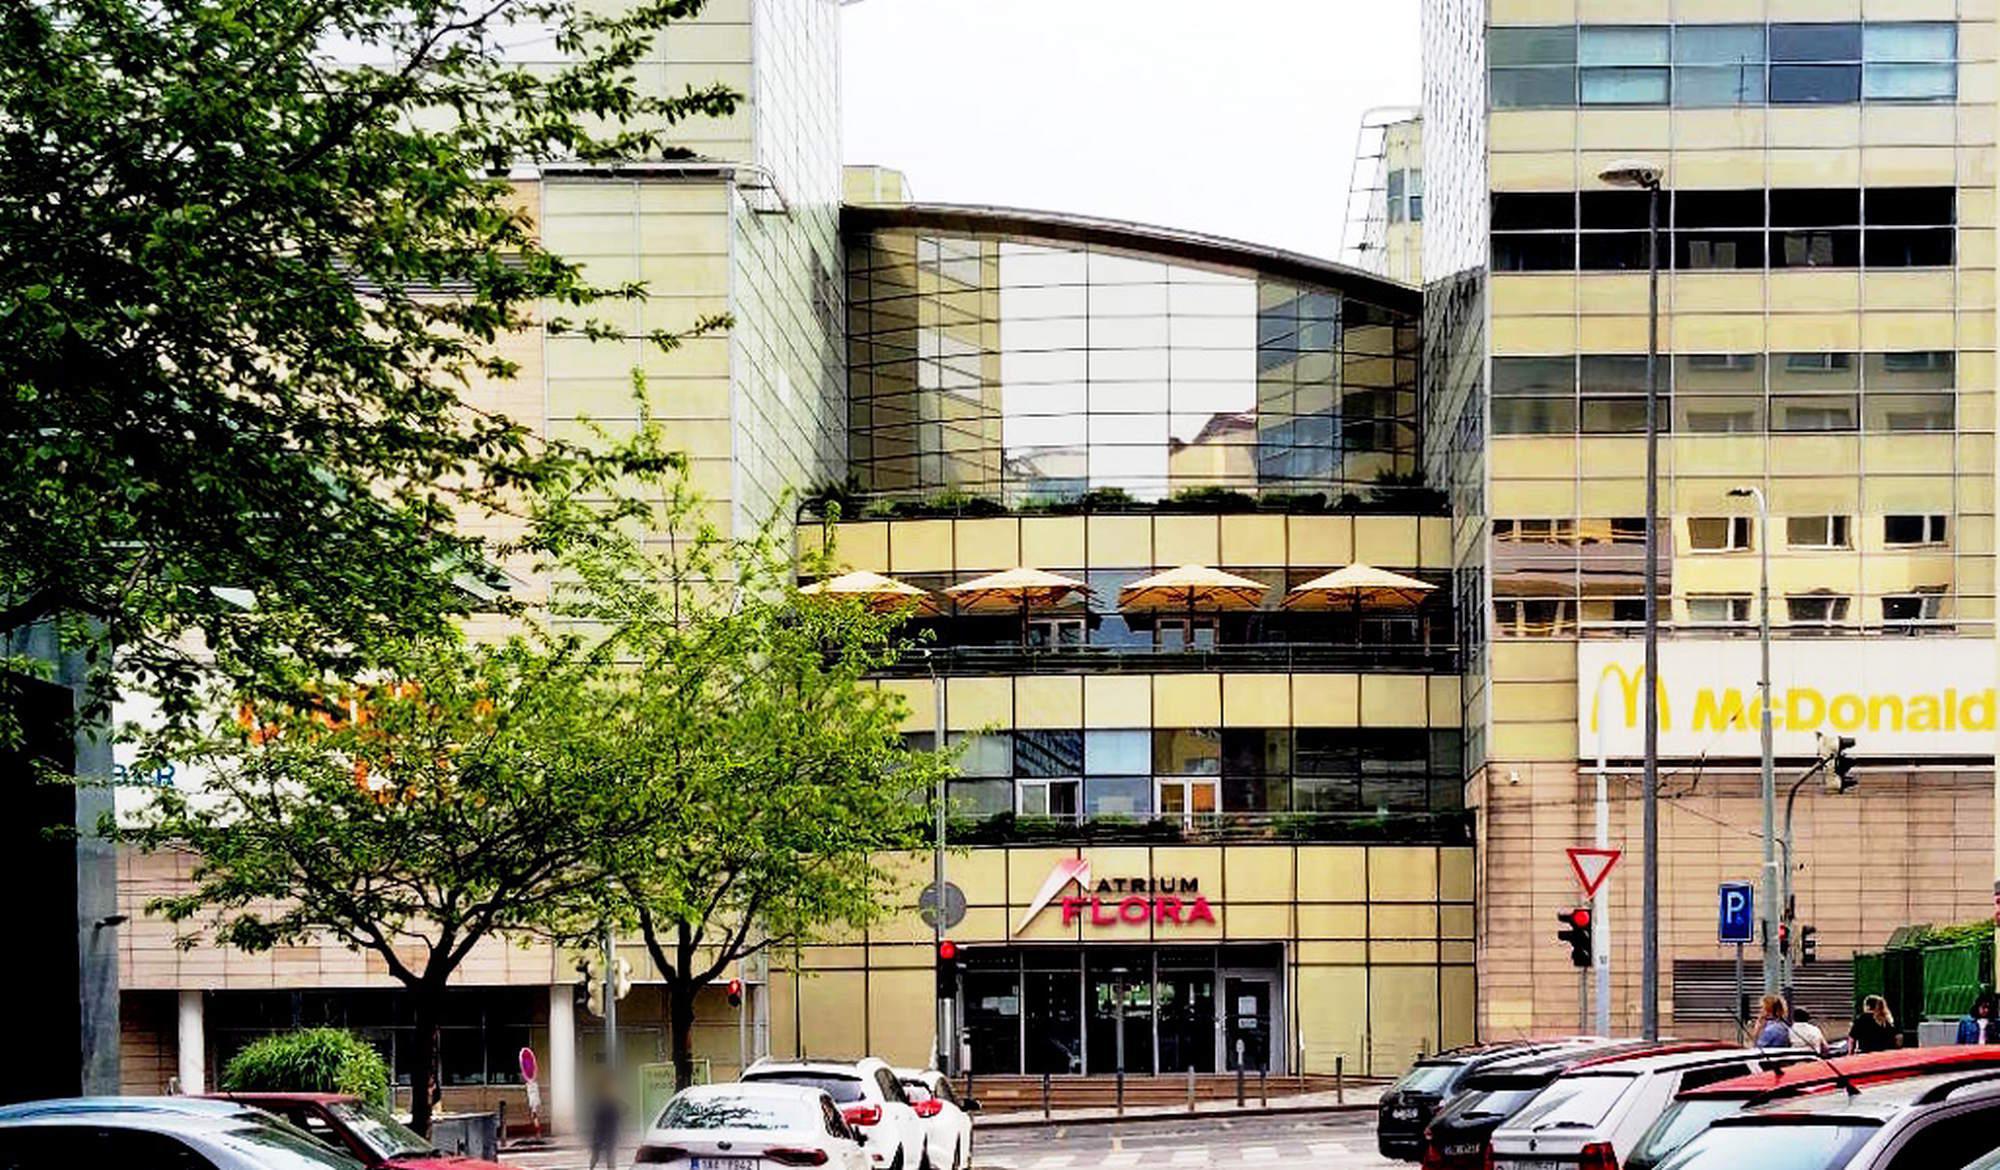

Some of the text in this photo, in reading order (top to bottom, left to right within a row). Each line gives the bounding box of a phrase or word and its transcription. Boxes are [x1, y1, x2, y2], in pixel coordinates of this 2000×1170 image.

[1691, 687, 1996, 733] McDonald
[1095, 877, 1199, 893] ATRIUM
[1062, 896, 1216, 928] FLORA
[1727, 891, 1745, 924] P
